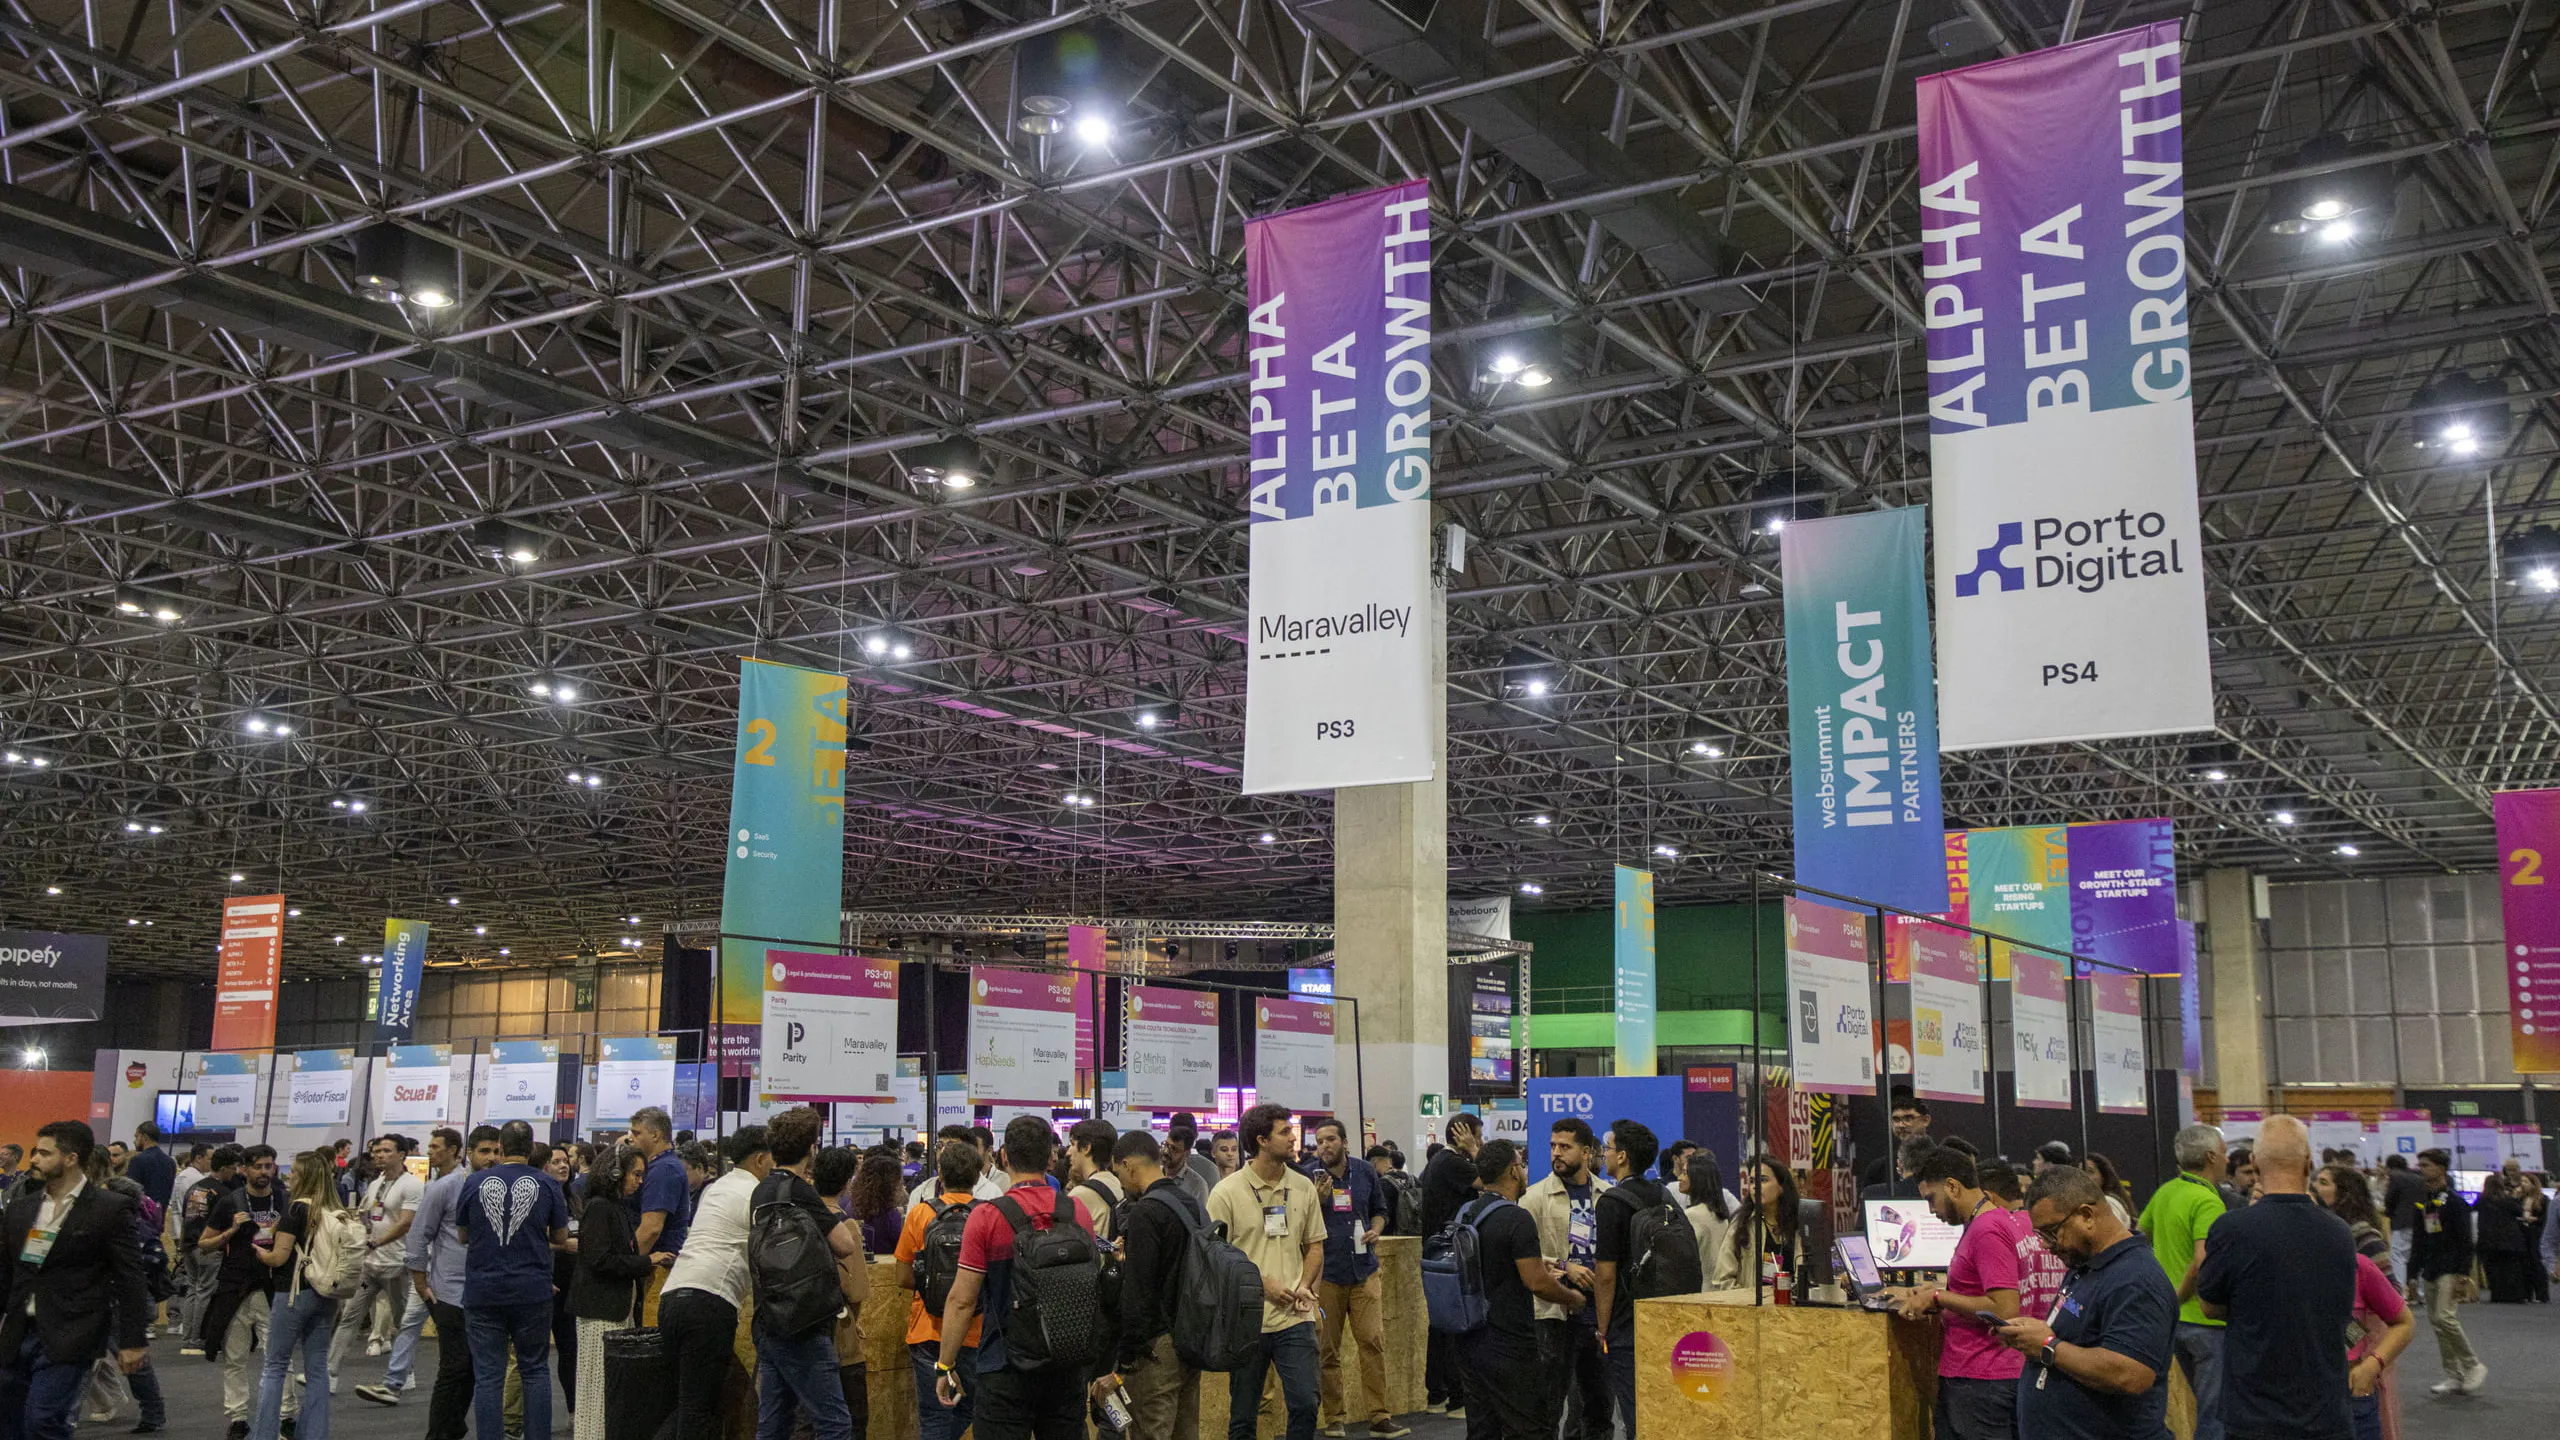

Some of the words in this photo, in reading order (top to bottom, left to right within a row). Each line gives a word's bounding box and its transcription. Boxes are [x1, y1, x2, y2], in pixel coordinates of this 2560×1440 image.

[2119, 40, 2192, 403] GROWTH
[1920, 160, 1987, 434] ALPHA
[2020, 203, 2091, 421] BETA
[1385, 197, 1431, 502] GROWTH
[1249, 292, 1287, 523] ALPHA
[1312, 331, 1357, 517] BETA
[2034, 508, 2166, 550] Porto
[2036, 538, 2183, 593] Digital
[1260, 603, 1411, 643] Maravalley
[2042, 661, 2098, 686] PS4
[1836, 601, 1893, 827] IMPACT
[1317, 719, 1355, 740] PS3
[744, 718, 777, 766] 2
[1815, 705, 1837, 829] websummit
[1897, 710, 1921, 823] PARTNERS
[752, 849, 778, 860] Security
[2094, 870, 2122, 879] MEET
[2124, 868, 2145, 878] OUR
[2509, 849, 2544, 885] 2
[1994, 883, 2020, 892] MEET
[2022, 882, 2042, 891] OUR
[2079, 877, 2162, 890] GROWTH-STAGE
[2095, 888, 2148, 898] STARTUPS
[1994, 901, 2045, 911] STARTUPS
[2003, 892, 2035, 901] RISING
[0, 945, 62, 968] pipefy
[386, 932, 410, 1027] Networking
[864, 968, 892, 980] PS3-01
[10, 979, 17, 987] in
[18, 979, 37, 989] days,
[39, 979, 51, 987] not
[52, 981, 78, 989] months
[1047, 984, 1071, 995] PS3-02
[1301, 983, 1332, 993] STAGE
[399, 989, 414, 1028] Area
[1847, 1004, 1866, 1020] Porto
[1847, 1020, 1869, 1039] Digital
[736, 1035, 750, 1044] the
[844, 1037, 888, 1053] Maravalley
[727, 1047, 750, 1056] world
[782, 1053, 807, 1065] Parity
[1033, 1047, 1068, 1062] Maravalley
[1182, 1058, 1212, 1070] Maravalley
[394, 1085, 425, 1102] Scua
[506, 1093, 536, 1102] Classbuild
[1540, 1093, 1593, 1112] TETO
